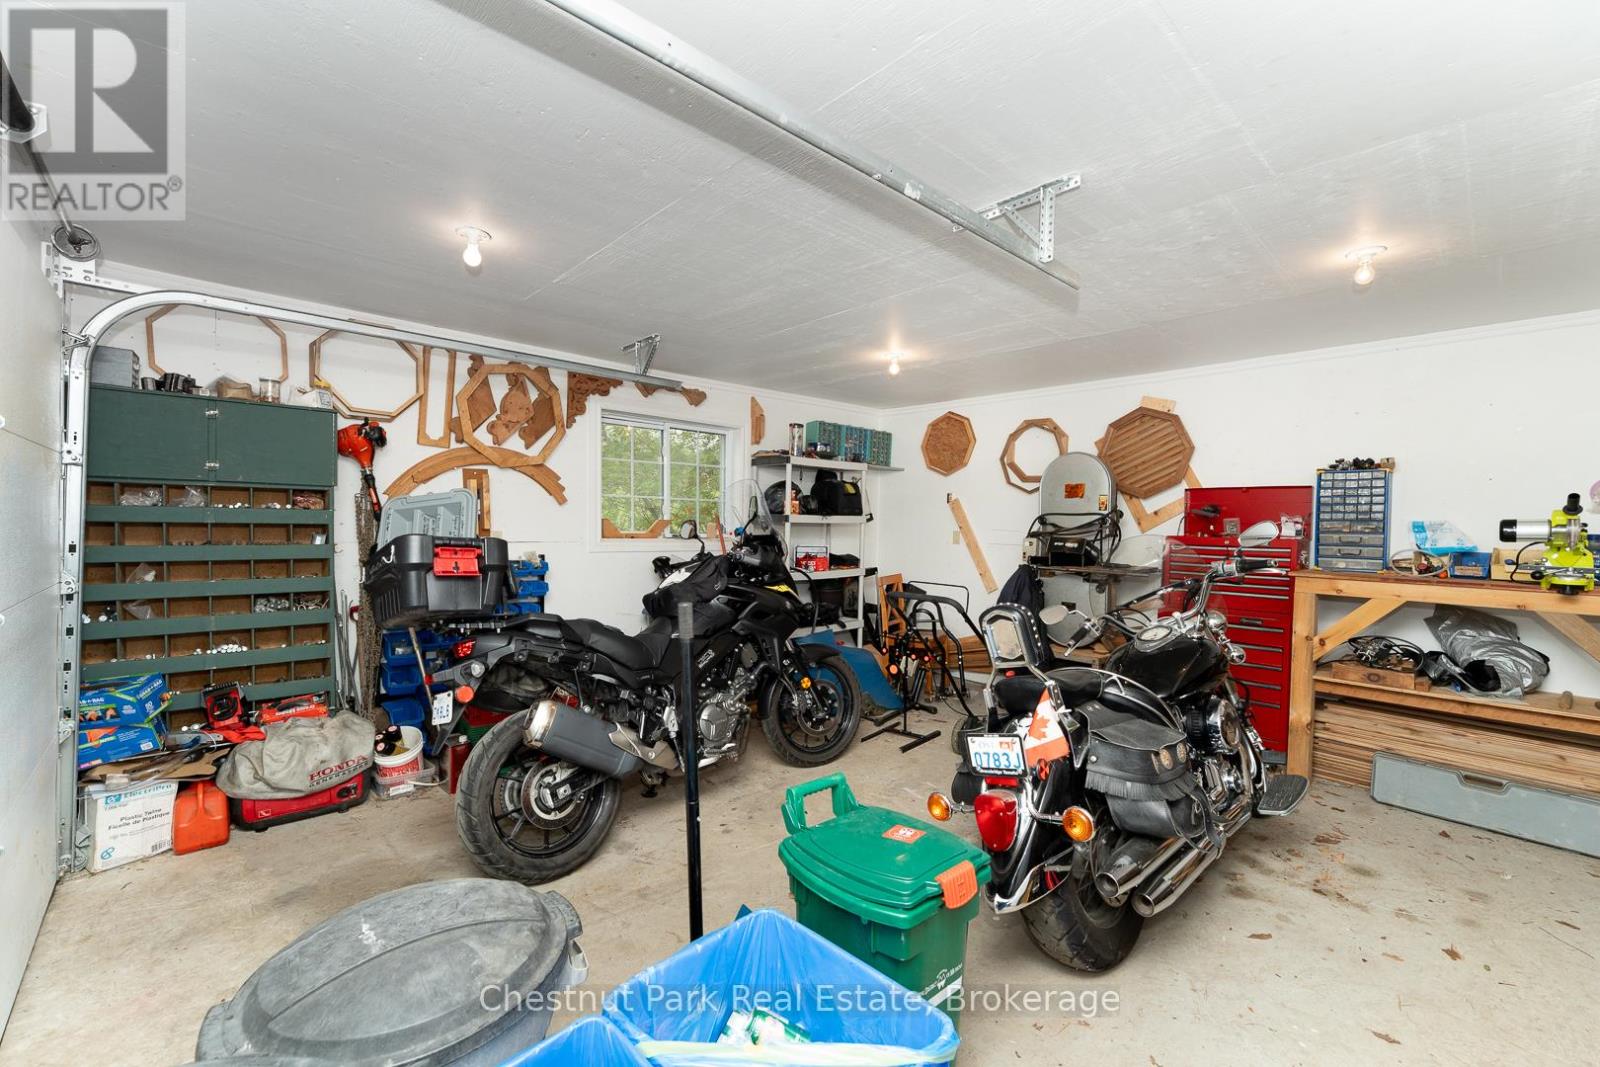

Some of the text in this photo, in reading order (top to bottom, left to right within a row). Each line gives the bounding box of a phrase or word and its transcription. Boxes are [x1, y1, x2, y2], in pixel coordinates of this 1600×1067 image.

[308, 754, 369, 782] HONDA
[120, 813, 143, 821] Plastic
[142, 811, 170, 822] Plastique
